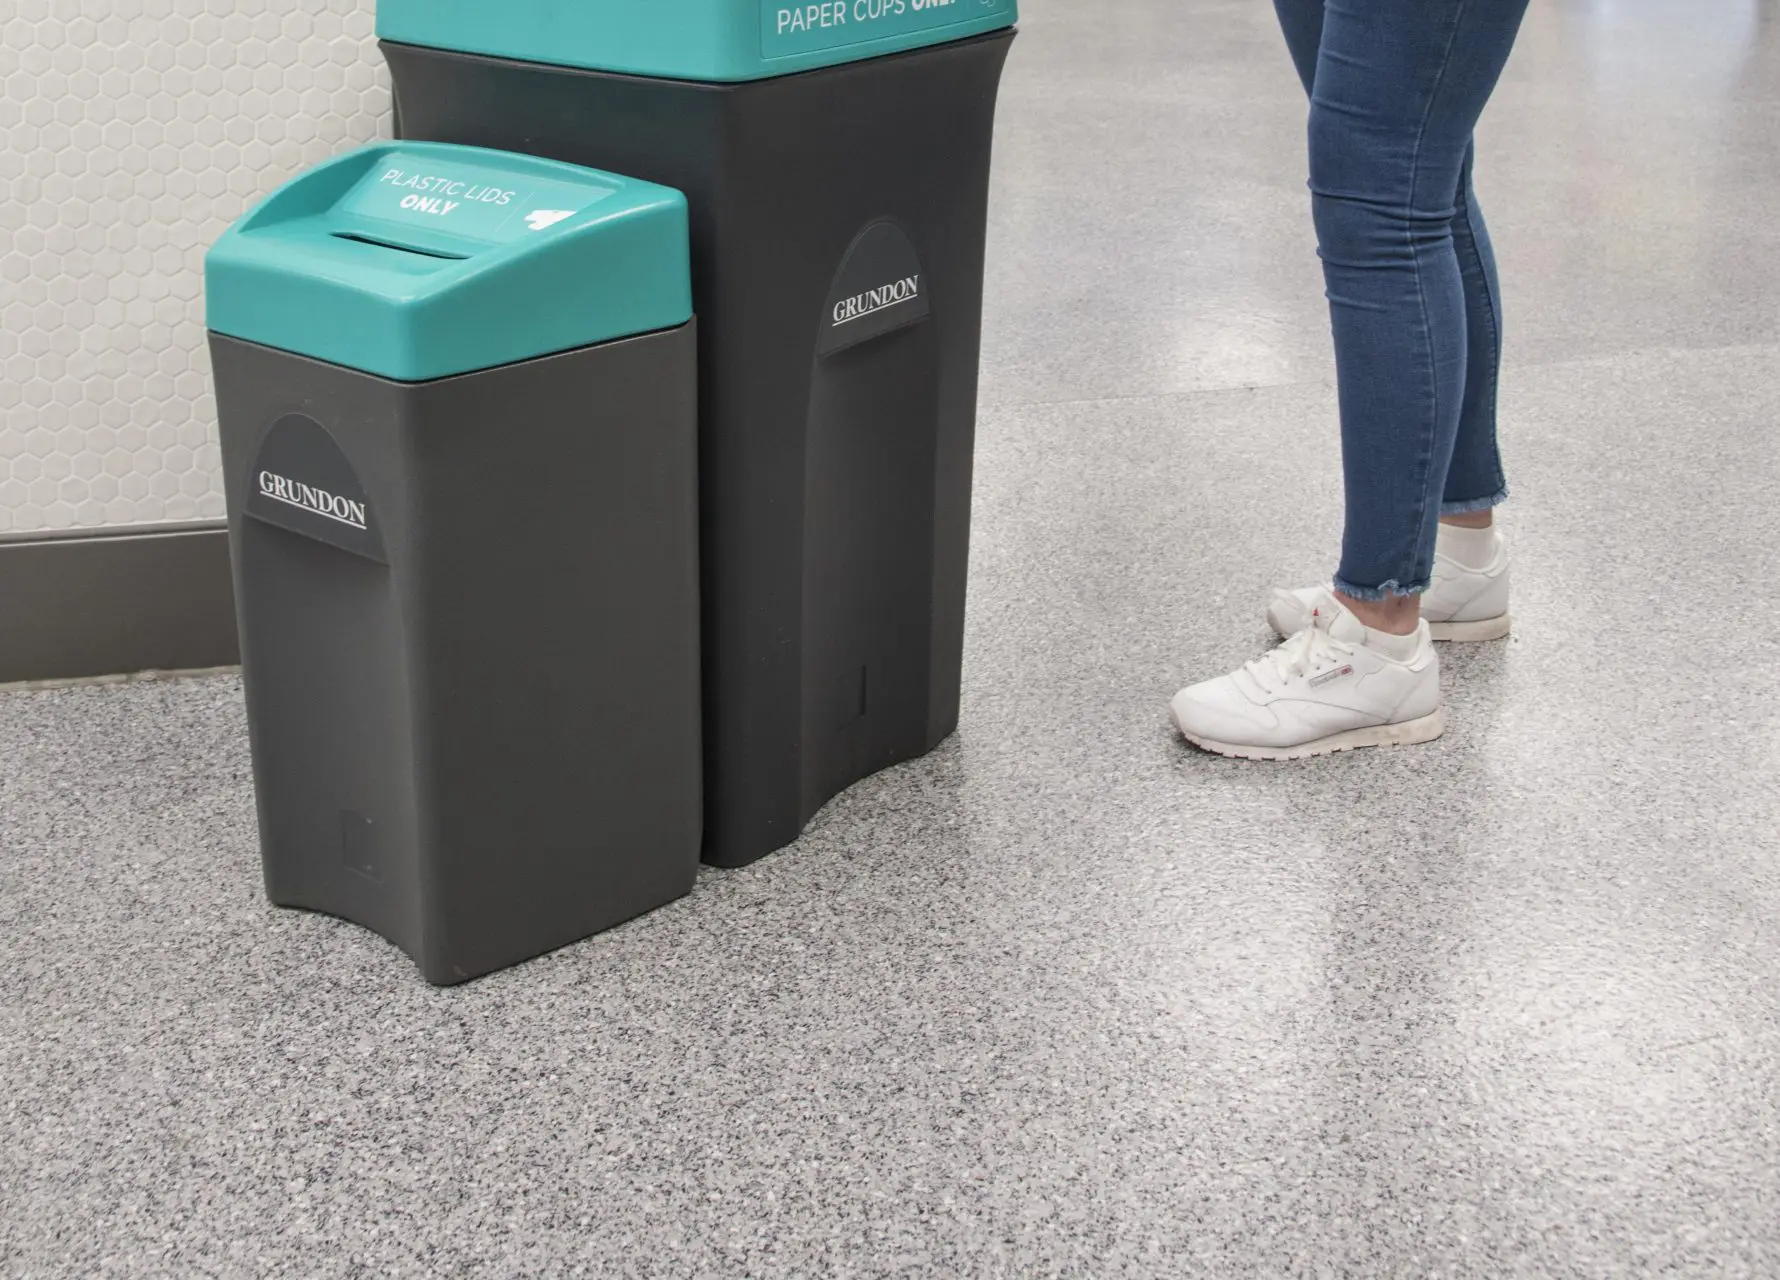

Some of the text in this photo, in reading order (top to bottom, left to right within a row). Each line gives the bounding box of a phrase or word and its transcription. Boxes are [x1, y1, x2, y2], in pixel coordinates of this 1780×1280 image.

[777, 1, 846, 35] PAPER
[380, 169, 516, 205] PLASTIC LIDS
[400, 194, 460, 216] ONLY
[832, 274, 919, 324] GRUNDON
[259, 470, 366, 526] GRUNDON
